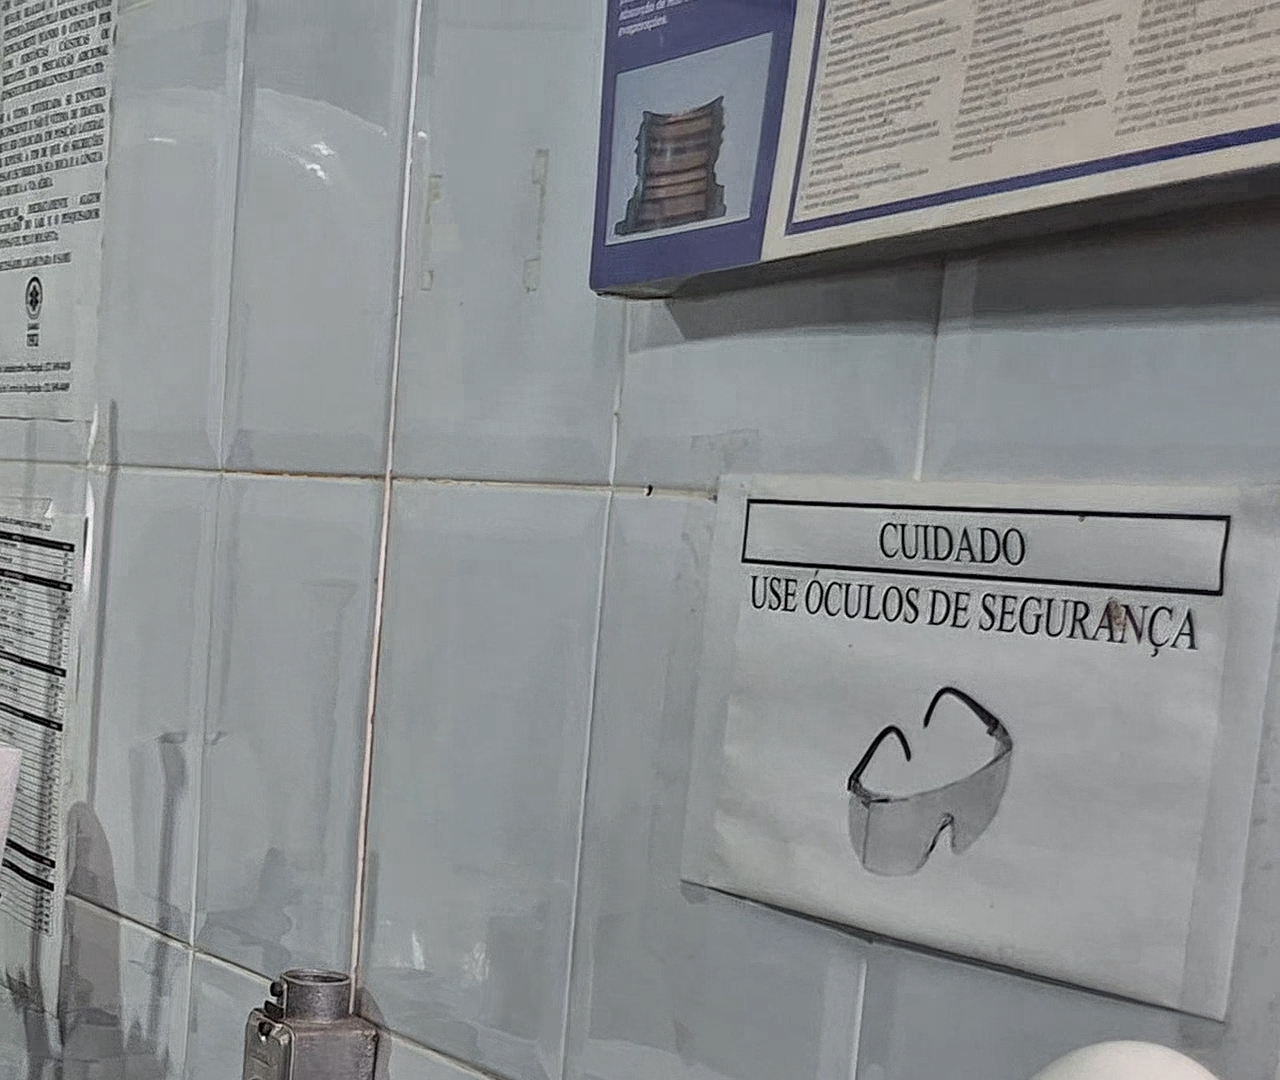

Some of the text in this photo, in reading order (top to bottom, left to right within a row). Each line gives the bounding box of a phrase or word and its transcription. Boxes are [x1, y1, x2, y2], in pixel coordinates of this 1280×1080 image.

[879, 522, 1026, 566] CUIDADO
[751, 570, 1198, 657] USE ÓCULOS DE SEGURANÇA
